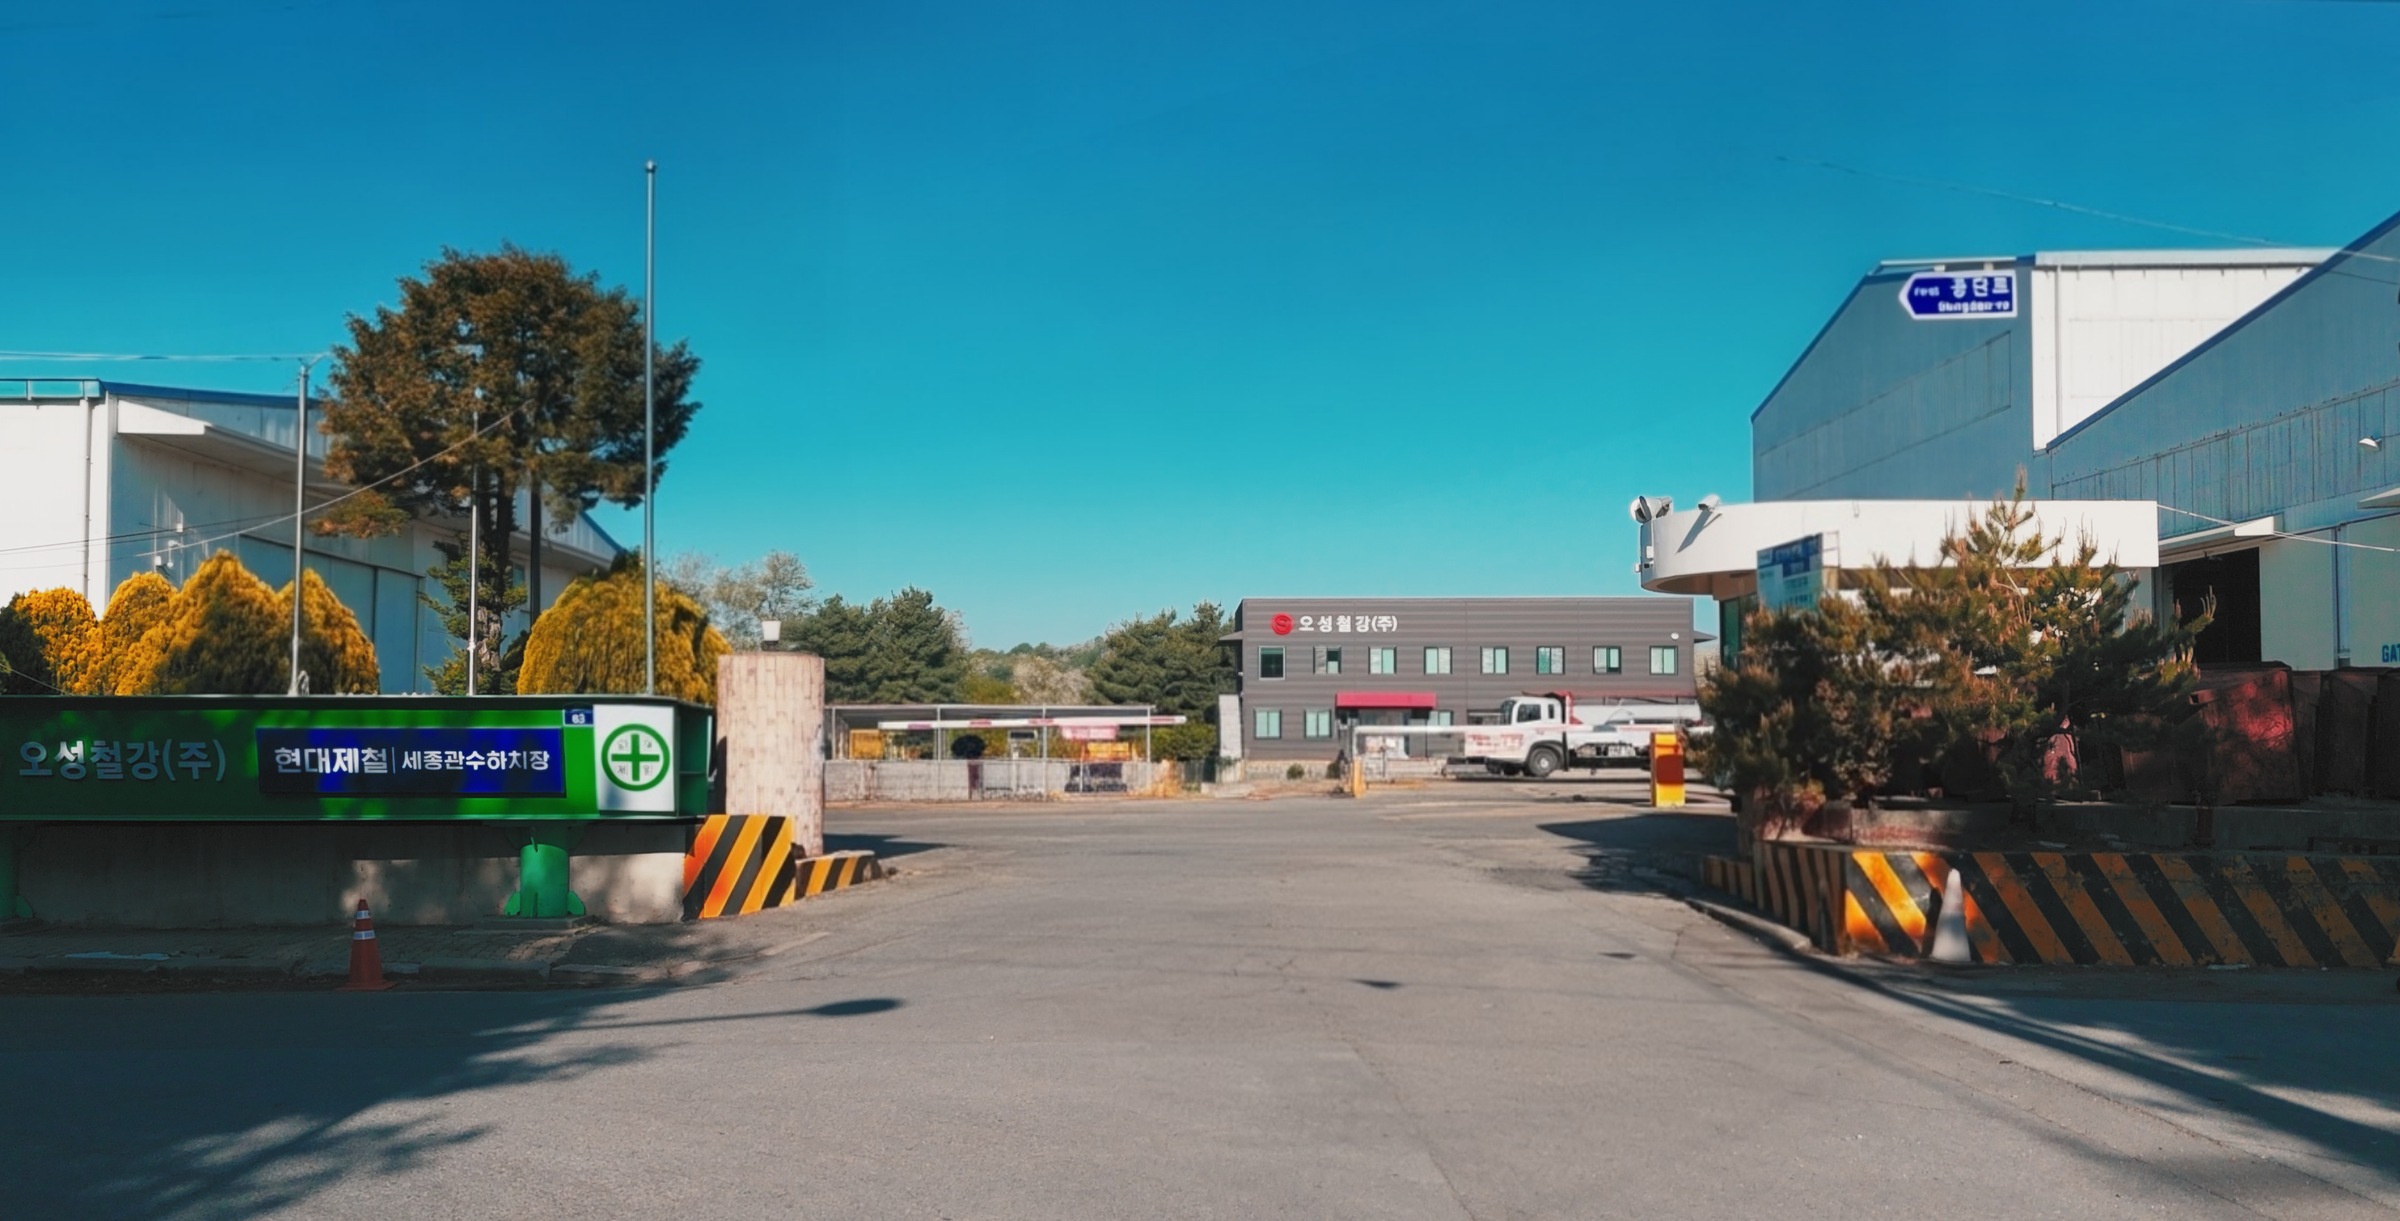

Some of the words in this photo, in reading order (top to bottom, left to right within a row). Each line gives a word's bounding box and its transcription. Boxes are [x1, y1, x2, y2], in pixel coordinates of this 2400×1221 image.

[1298, 615, 1398, 633] 오성철강(주)
[571, 713, 586, 724] 63
[19, 739, 226, 782] 오성철강(주)
[274, 747, 389, 775] 현대제철
[401, 750, 551, 772] 세종관수하치장
